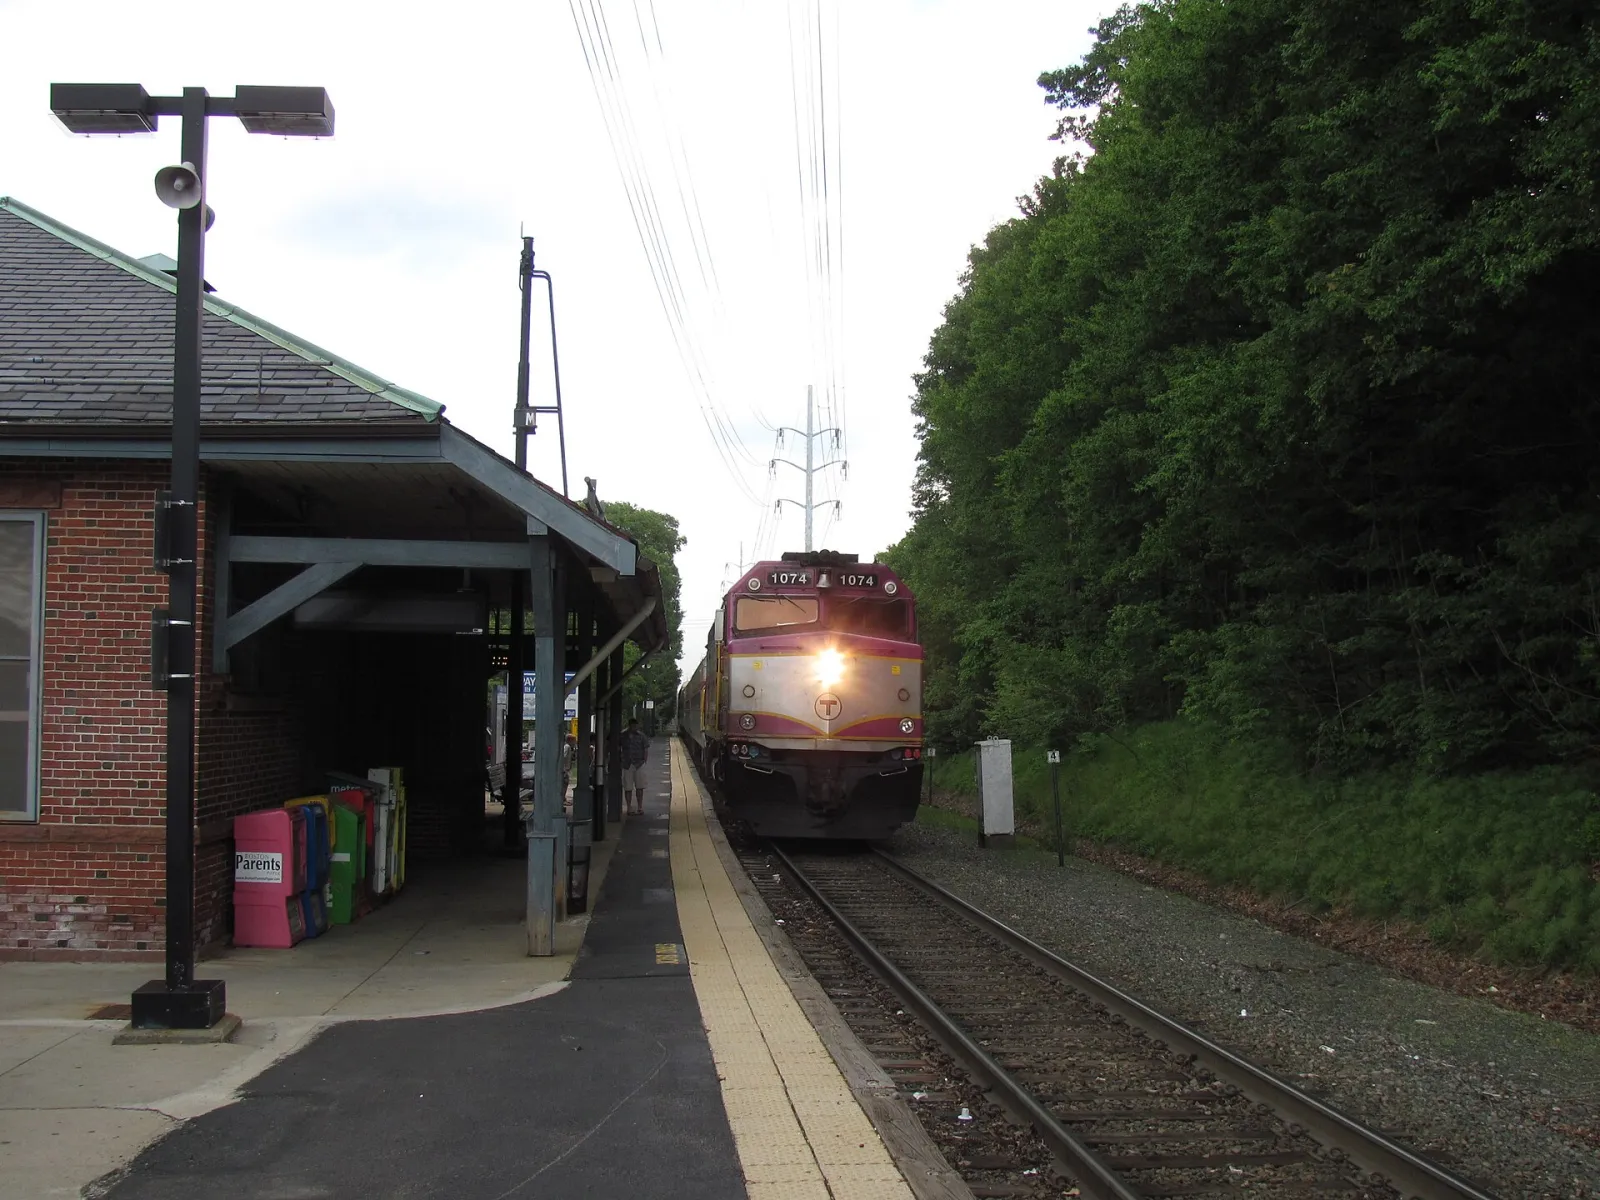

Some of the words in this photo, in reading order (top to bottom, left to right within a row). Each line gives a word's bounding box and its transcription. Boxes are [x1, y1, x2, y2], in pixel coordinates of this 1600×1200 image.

[771, 573, 807, 584] 1074
[840, 575, 873, 586] 1074
[523, 677, 536, 686] AY
[819, 700, 837, 716] T
[1050, 752, 1056, 760] 4
[236, 854, 280, 871] Parents
